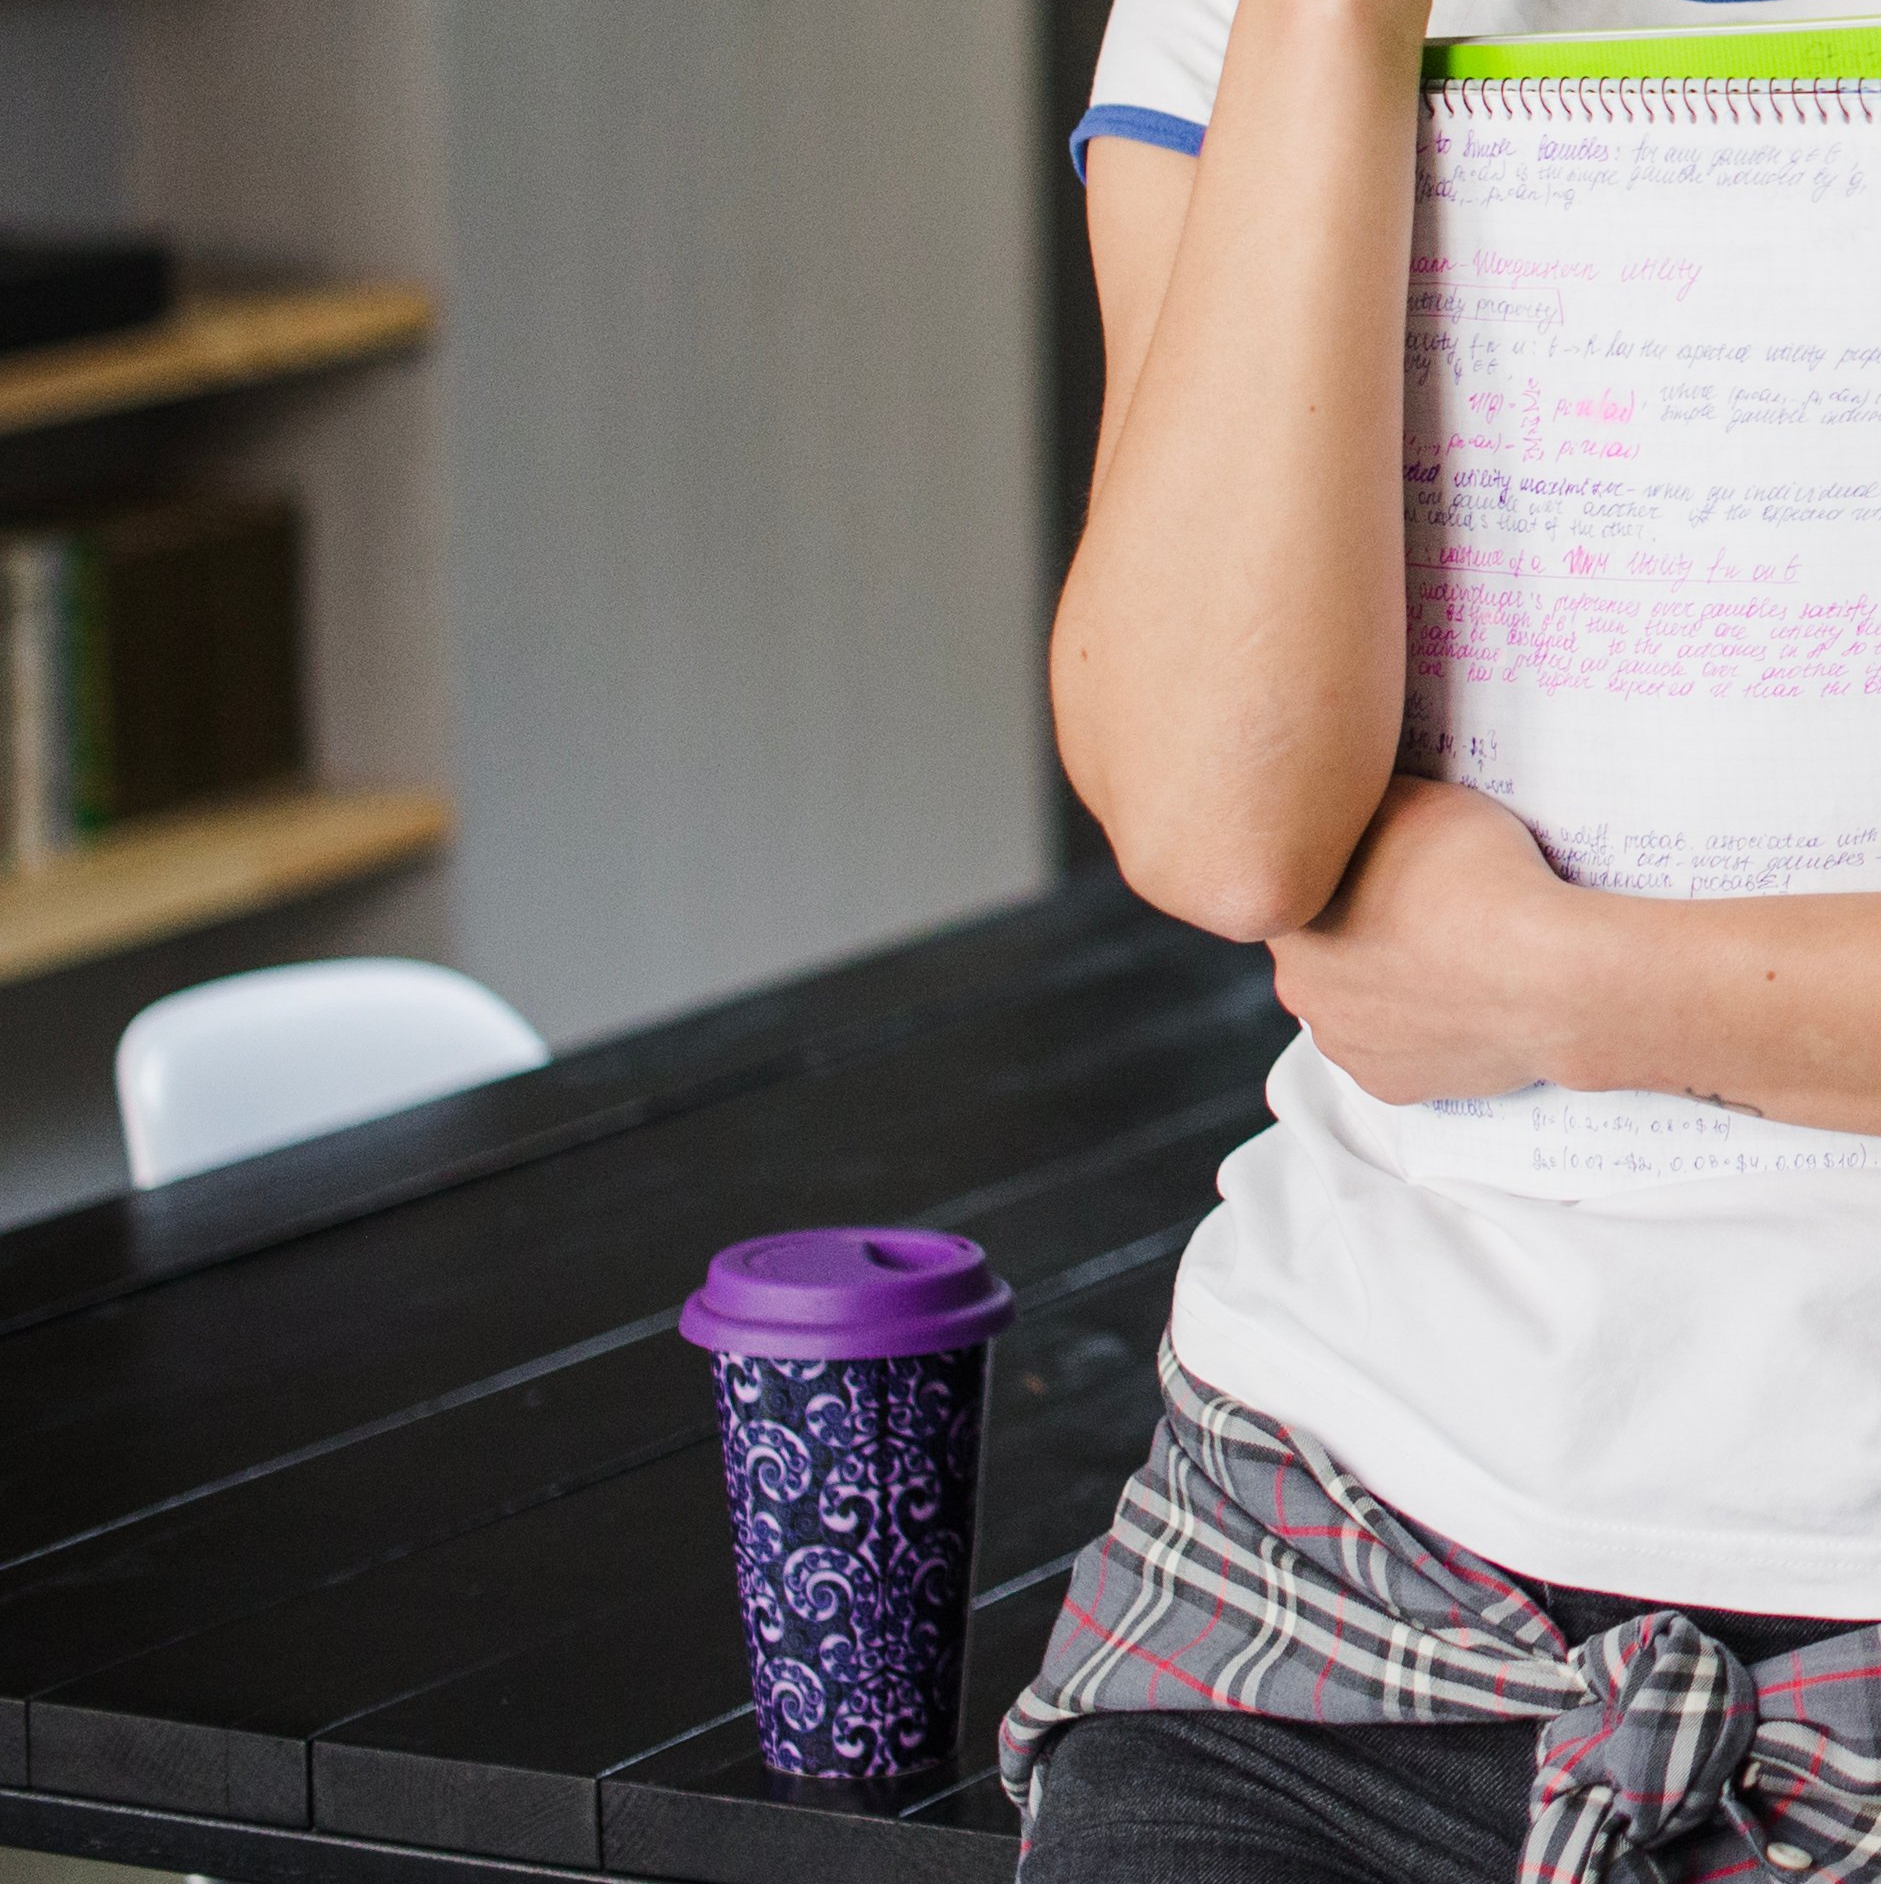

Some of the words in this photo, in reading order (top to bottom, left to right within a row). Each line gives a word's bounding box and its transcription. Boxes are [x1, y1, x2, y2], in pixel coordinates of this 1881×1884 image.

[1435, 130, 1452, 155] to
[1620, 257, 1704, 302] utility
[1766, 341, 1828, 372] utility
[1453, 466, 1512, 492] utility
[1744, 480, 1881, 504] individual
[1583, 499, 1665, 520] another
[1497, 515, 1537, 534] that
[1552, 594, 1641, 623] preferences
[1650, 600, 1696, 618] over
[1697, 595, 1787, 627] gambles
[1799, 593, 1879, 623] satisfy
[1470, 626, 1488, 645] be
[1506, 628, 1578, 655] assigned
[1607, 638, 1627, 655] to
[1634, 637, 1663, 656] the
[1586, 617, 1631, 636] then
[1643, 620, 1701, 640] there
[1714, 622, 1747, 641] are
[1616, 658, 1688, 679] gamble
[1702, 661, 1741, 678] over
[1760, 662, 1850, 681] another
[1606, 678, 1696, 701] expected
[1742, 681, 1805, 699] than
[1820, 681, 1852, 698] the
[1706, 832, 1825, 852] associated
[1836, 826, 1879, 848] with
[1766, 853, 1866, 882] gambles
